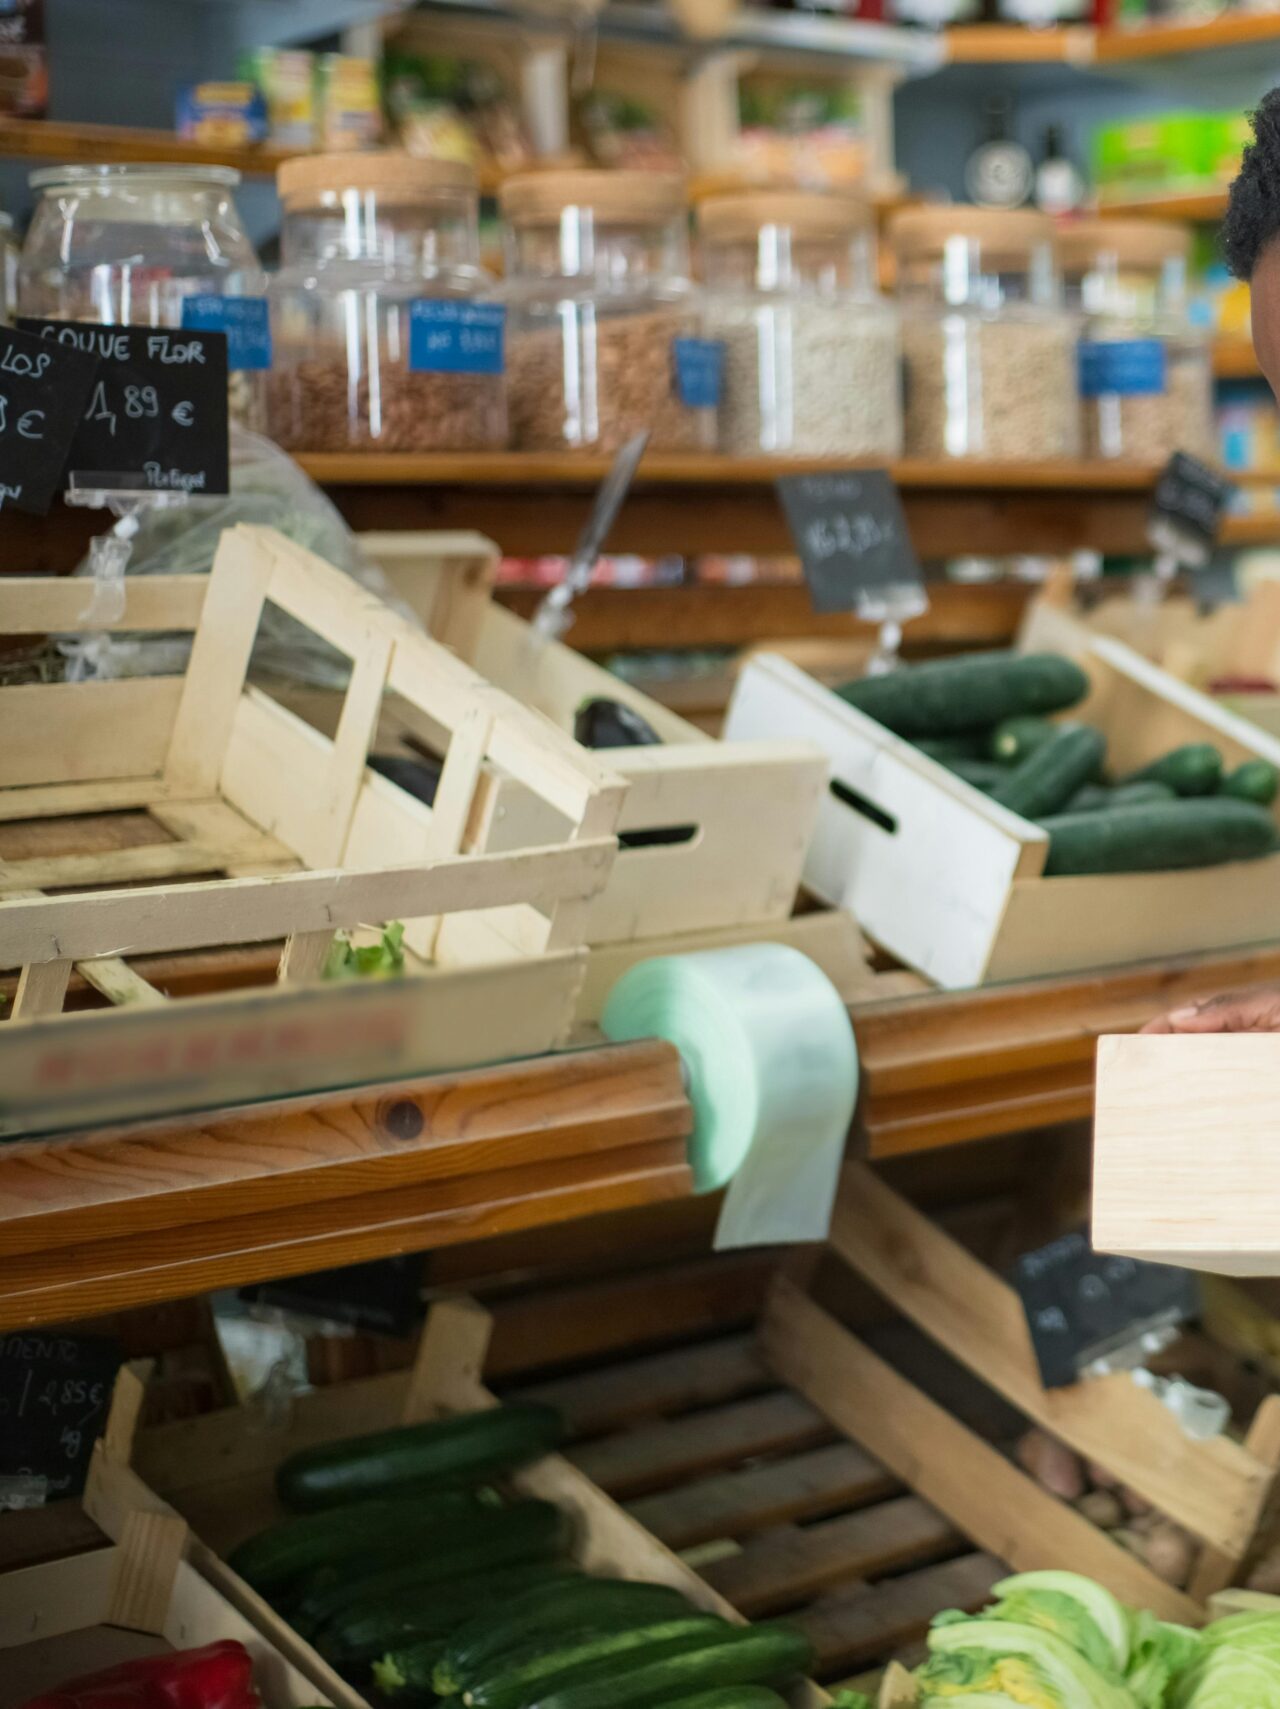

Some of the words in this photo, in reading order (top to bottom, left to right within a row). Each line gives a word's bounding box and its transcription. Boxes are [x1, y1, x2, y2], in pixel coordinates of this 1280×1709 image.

[0, 344, 50, 378] LOS
[147, 335, 206, 364] FLOR
[85, 380, 159, 437] 1,89
[171, 400, 195, 427] €
